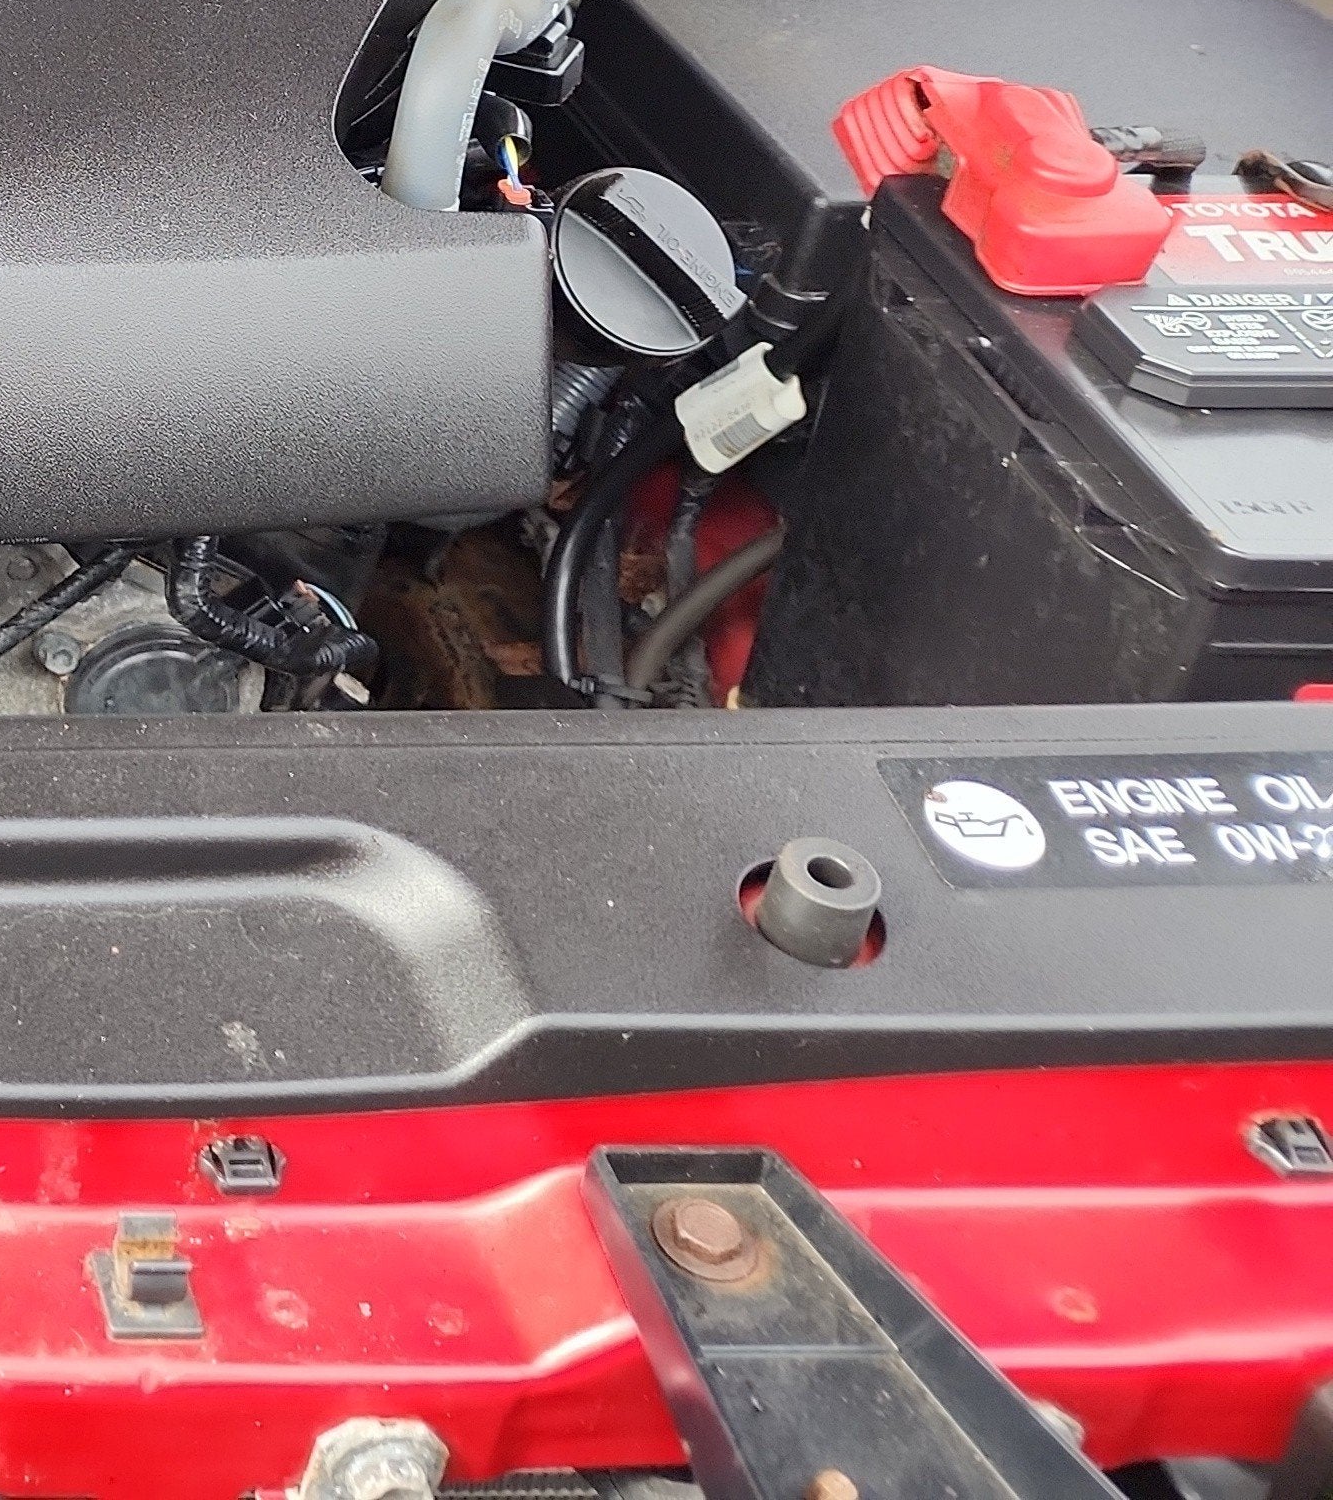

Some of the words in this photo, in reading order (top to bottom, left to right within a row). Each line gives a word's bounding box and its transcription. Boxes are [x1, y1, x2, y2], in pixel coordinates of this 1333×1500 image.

[1170, 202, 1318, 218] TOYOTA
[1187, 293, 1300, 306] DANGER
[1048, 777, 1237, 816] ENGINE
[1083, 827, 1197, 864] SAE
